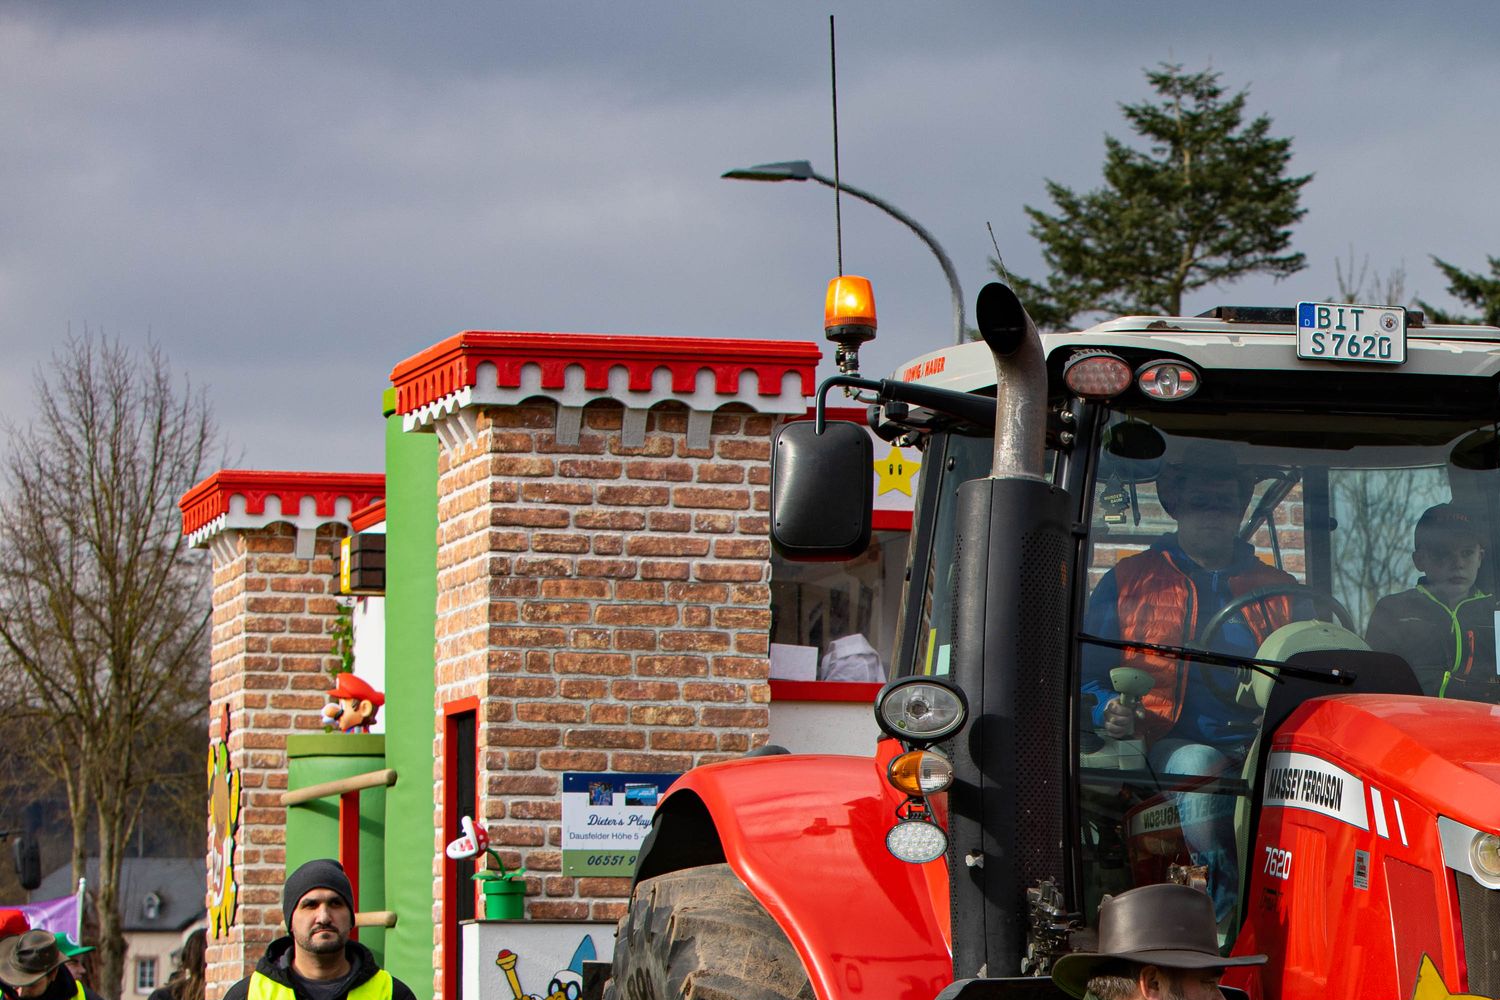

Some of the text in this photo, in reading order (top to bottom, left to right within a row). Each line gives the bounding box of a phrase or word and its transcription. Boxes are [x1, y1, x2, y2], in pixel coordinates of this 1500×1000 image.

[1304, 318, 1311, 327] D
[1317, 306, 1365, 332] BIT
[1267, 767, 1344, 812] MASSEY FERGUSON
[568, 831, 610, 841] Dausfelder
[611, 830, 633, 840] Höhe
[633, 831, 640, 840] 5
[586, 854, 625, 866] 06551
[1263, 846, 1293, 881] 7620
